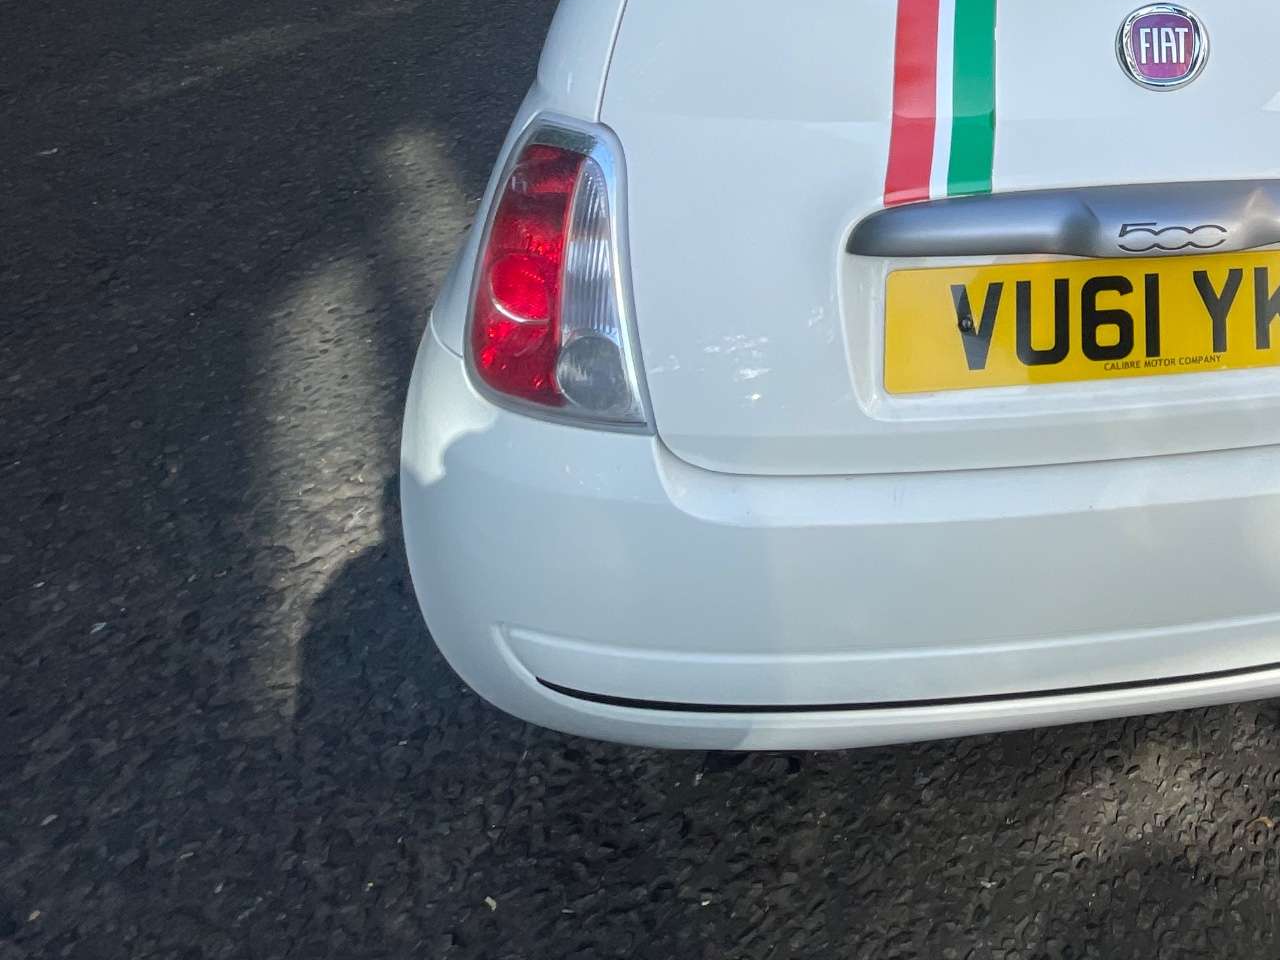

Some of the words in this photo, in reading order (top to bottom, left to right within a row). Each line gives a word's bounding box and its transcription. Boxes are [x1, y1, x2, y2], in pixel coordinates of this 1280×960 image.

[1139, 26, 1189, 65] FIAT
[1117, 222, 1228, 253] 500
[950, 272, 1160, 372] VU61
[1103, 359, 1141, 372] CALIBRE
[1143, 357, 1177, 369] MOTOR
[1179, 354, 1222, 367] COMPANY
